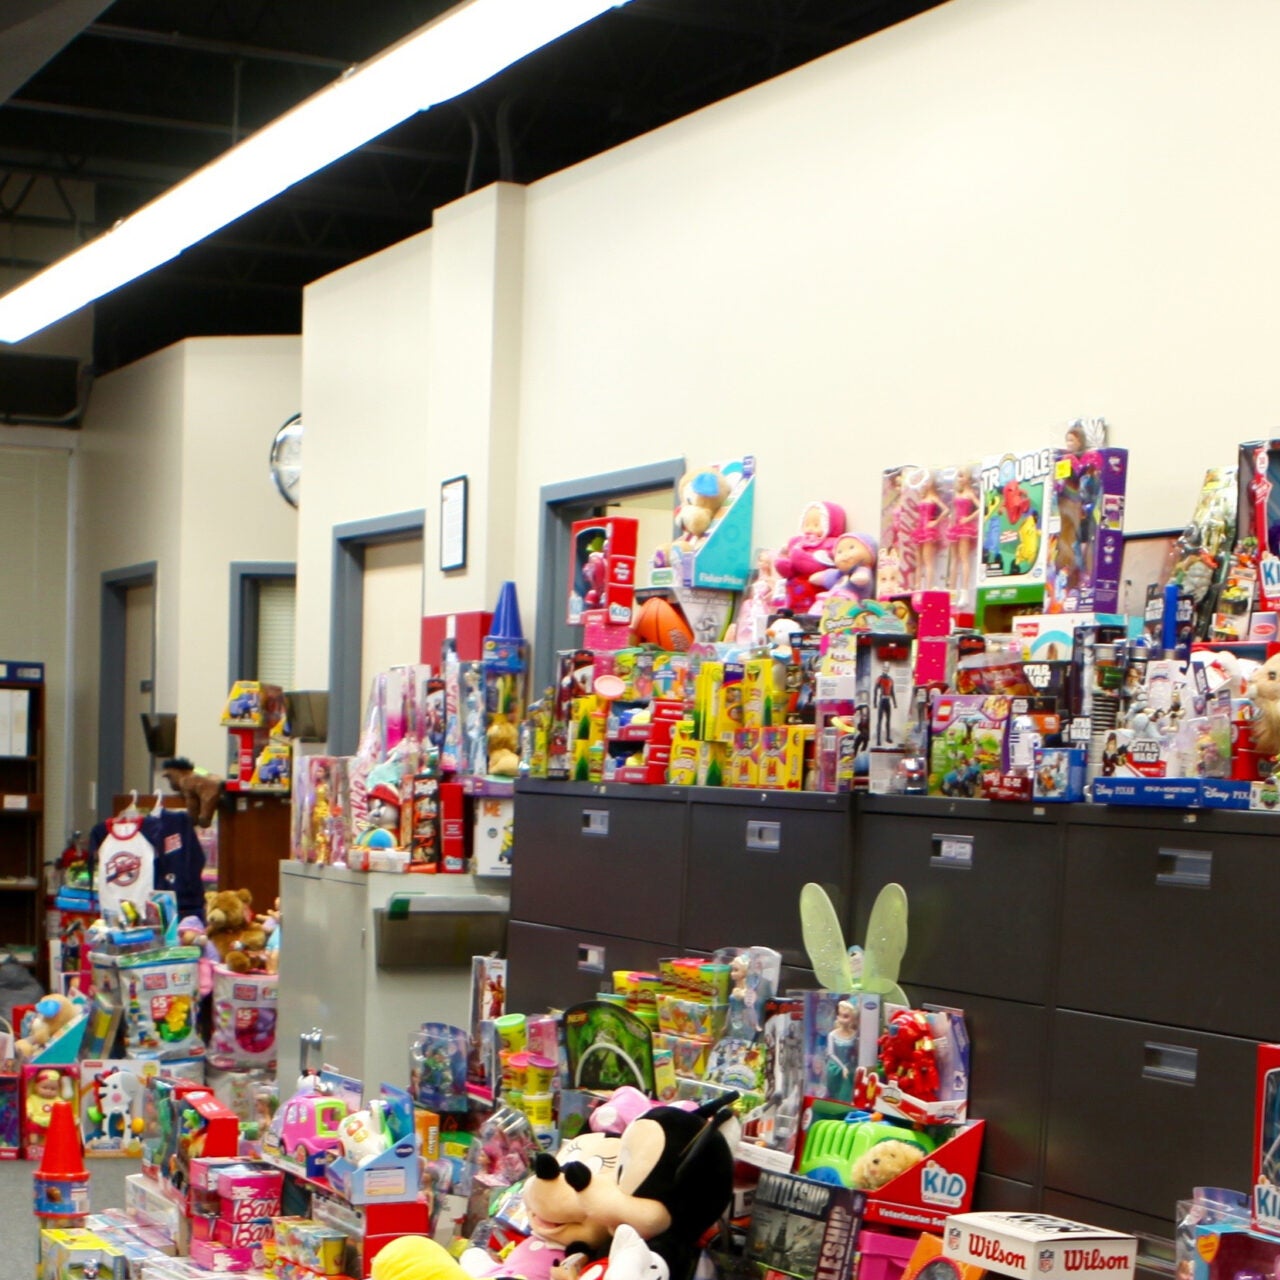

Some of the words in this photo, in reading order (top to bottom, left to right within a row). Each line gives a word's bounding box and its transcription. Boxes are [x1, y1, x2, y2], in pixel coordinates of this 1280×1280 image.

[923, 1168, 963, 1199] KID
[879, 1206, 928, 1226] Veterinarian
[968, 1233, 1027, 1270] Wilson
[1063, 1248, 1130, 1271] Wilson
